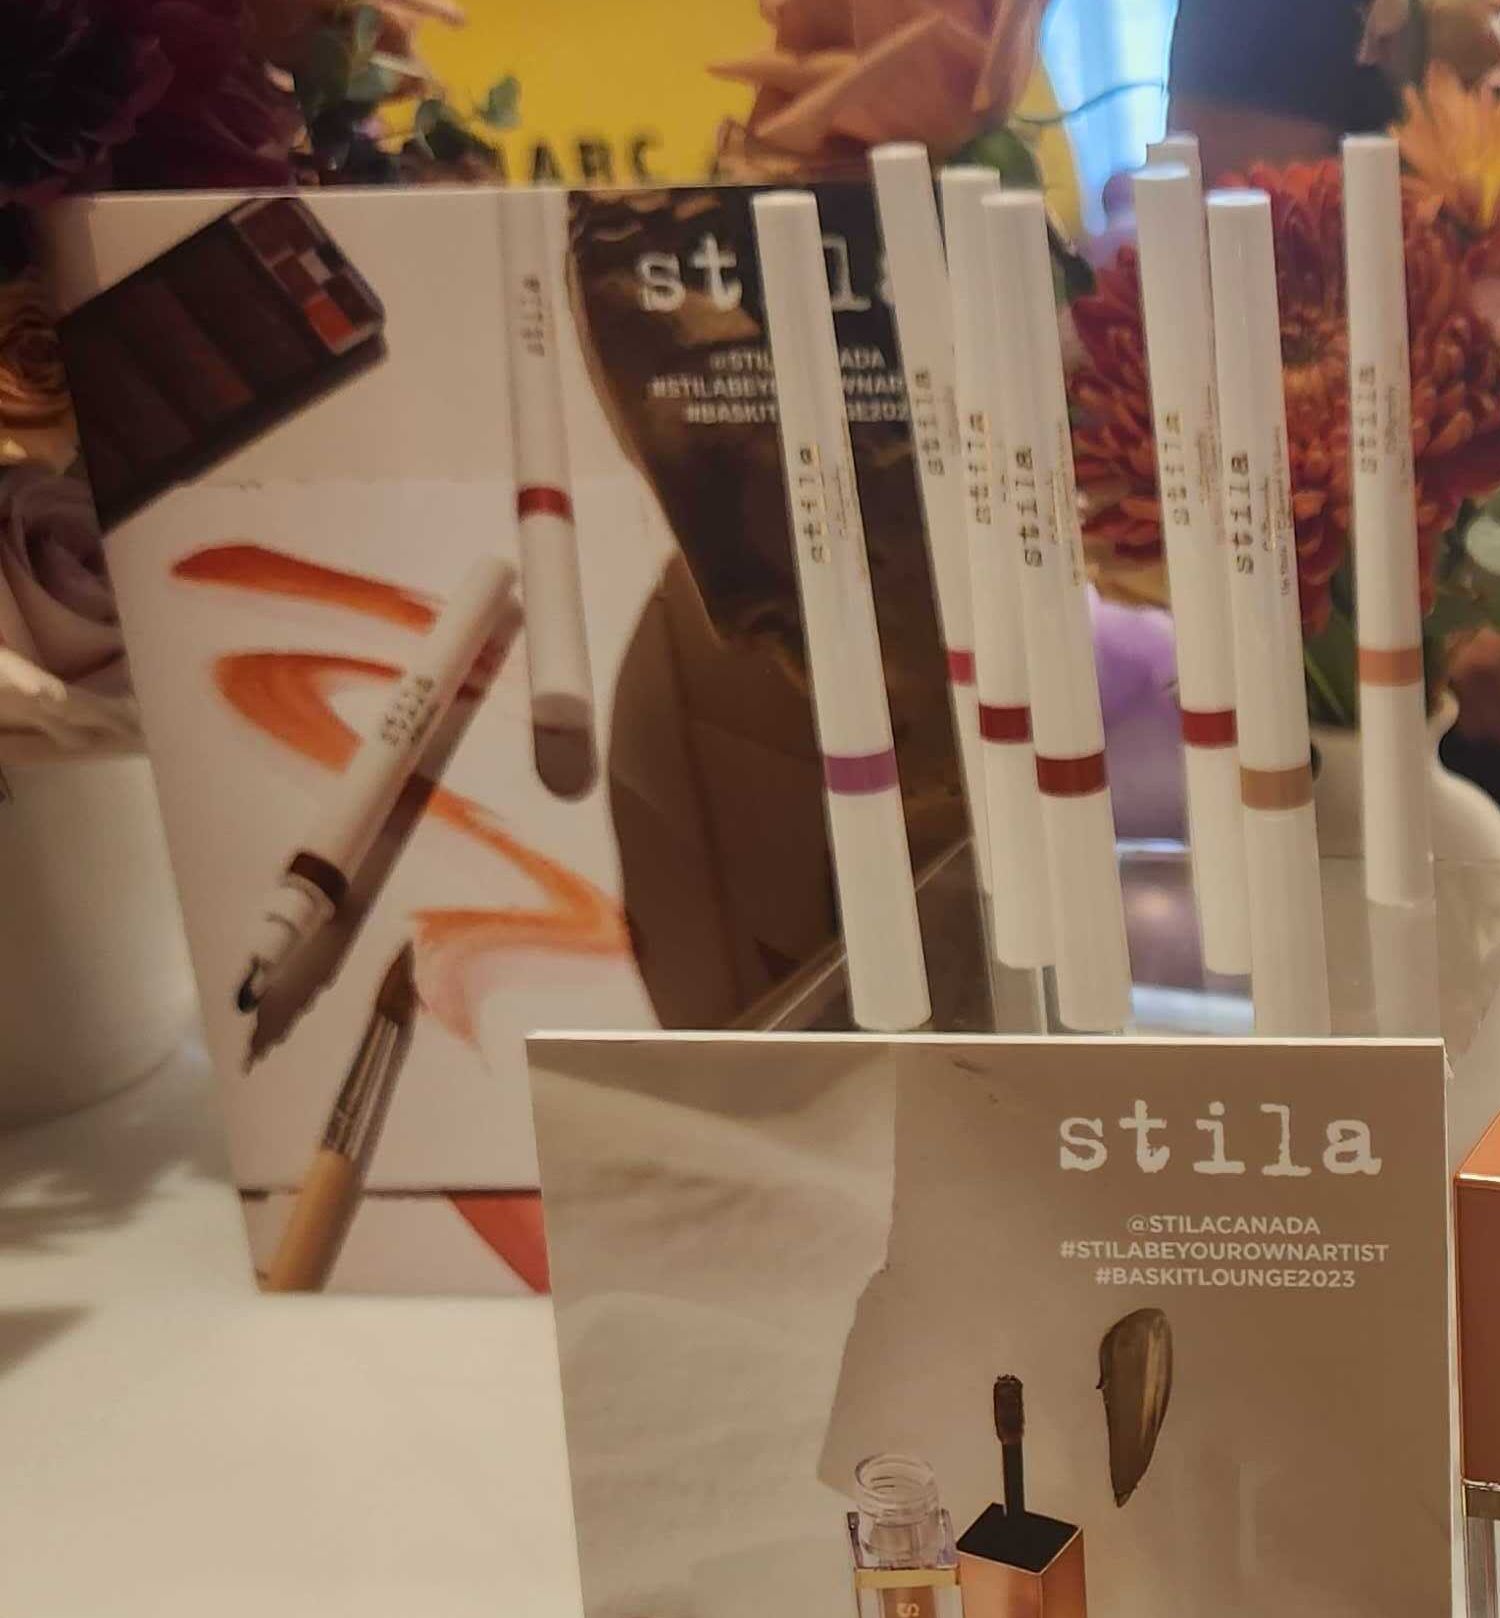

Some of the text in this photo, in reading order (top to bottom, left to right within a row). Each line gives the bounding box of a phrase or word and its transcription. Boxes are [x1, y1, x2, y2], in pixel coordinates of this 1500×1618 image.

[636, 232, 893, 312] stl
[1015, 447, 1043, 568] stila
[1229, 452, 1255, 575] stila
[1059, 1099, 1383, 1177] stila
[1058, 1240, 1389, 1262] #STILABEYOUROWNARTIST
[1127, 1214, 1321, 1236] @STILACANADA
[1095, 1267, 1356, 1289] #BASKITLOUNGE2023
